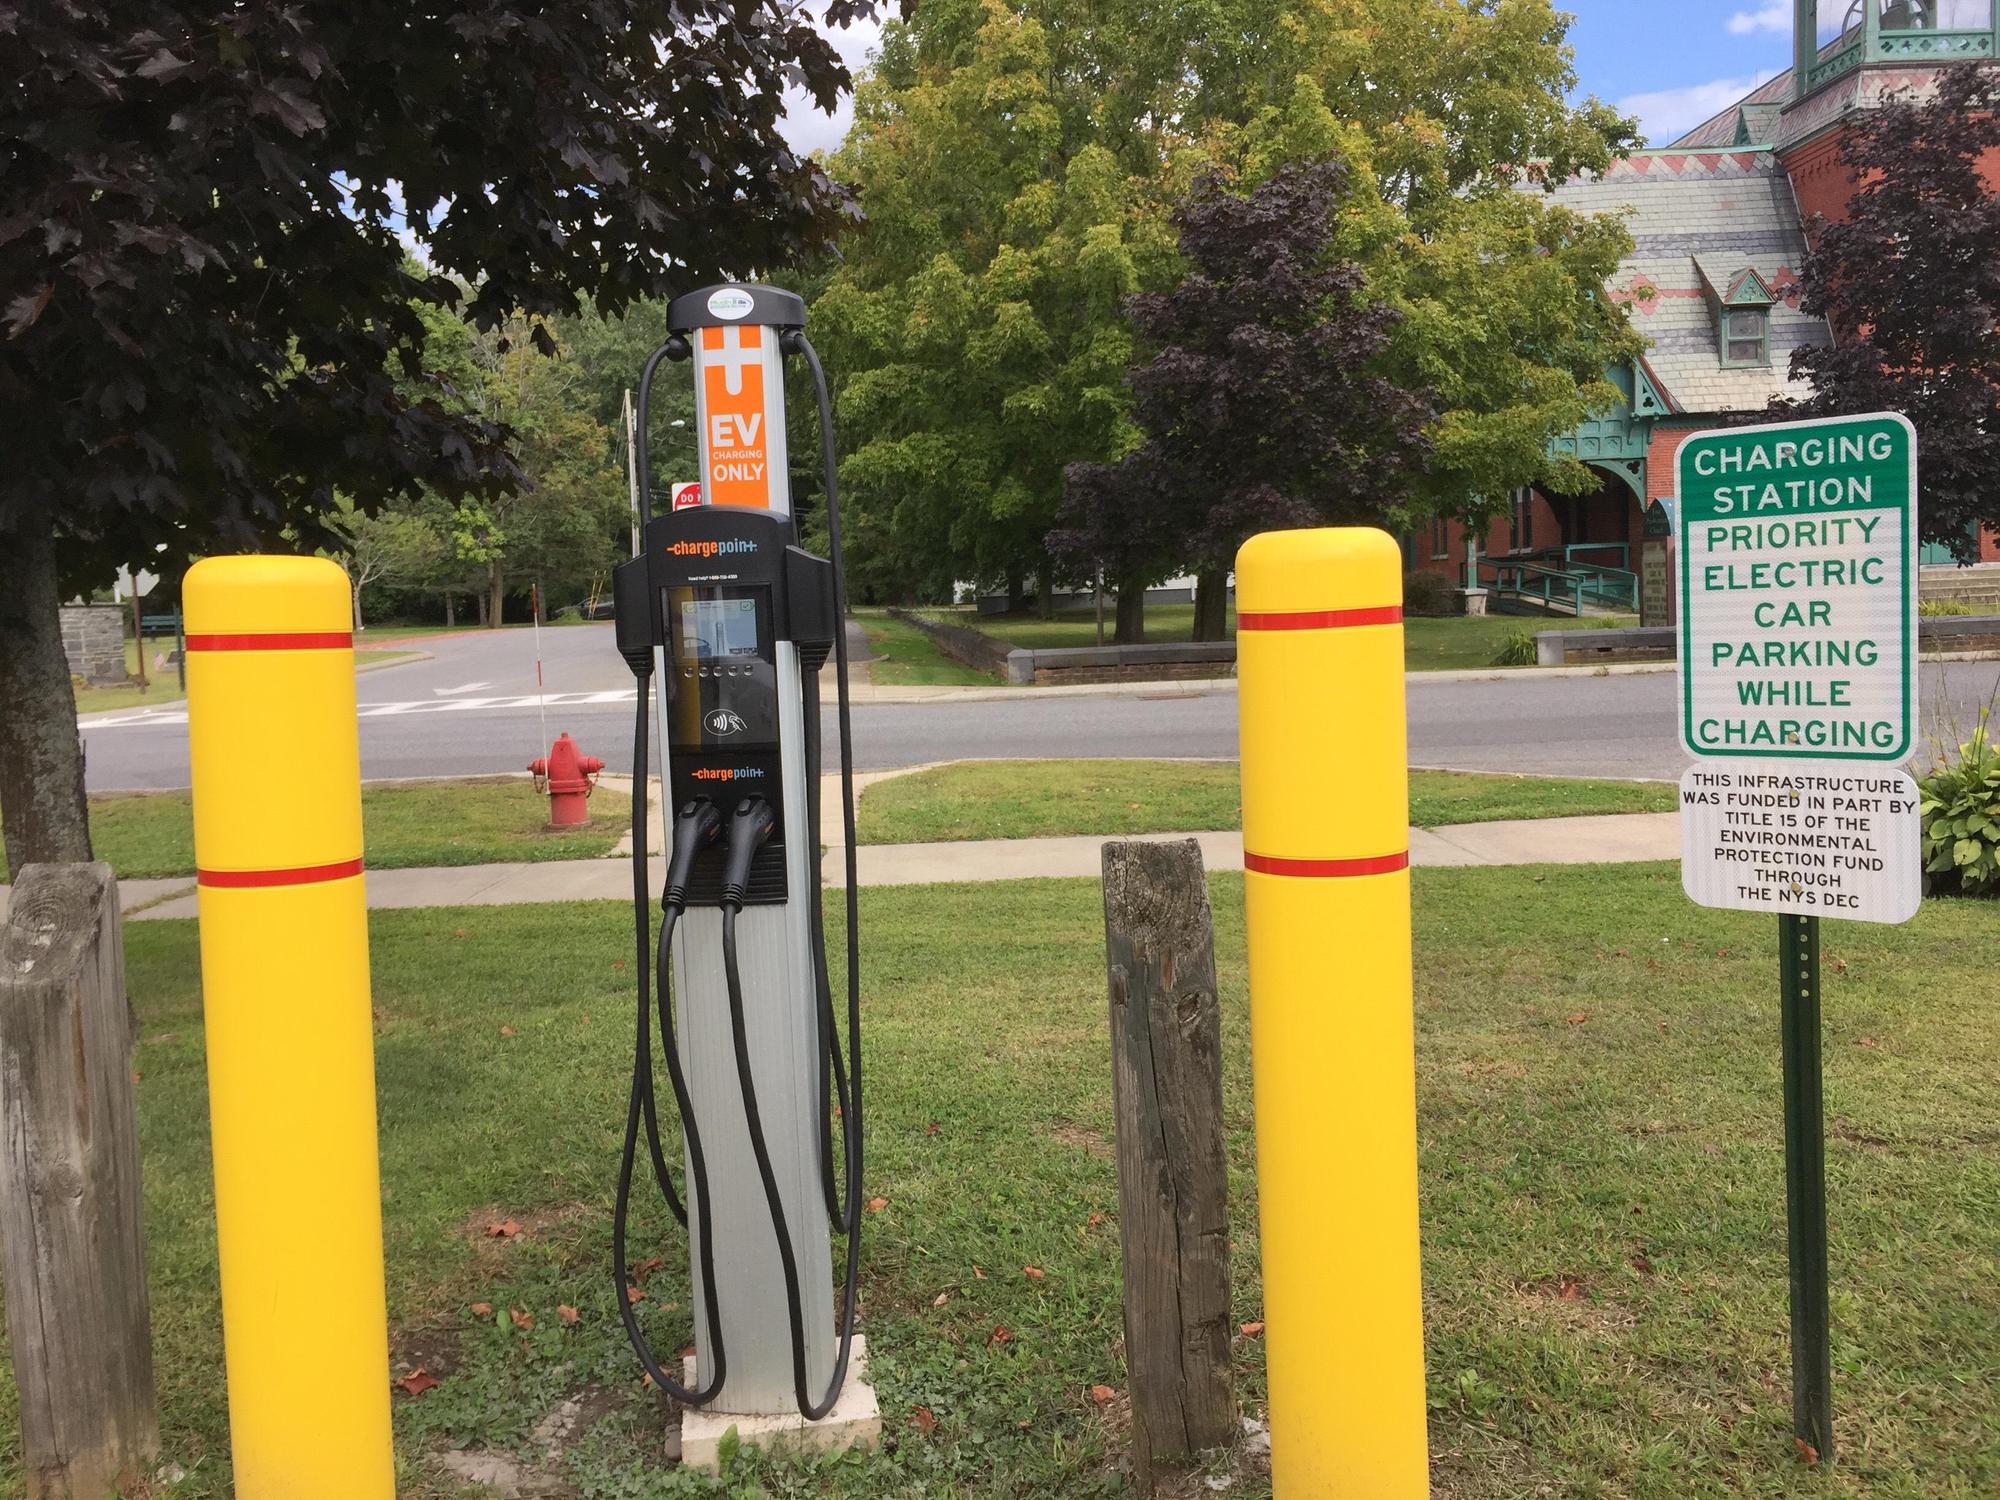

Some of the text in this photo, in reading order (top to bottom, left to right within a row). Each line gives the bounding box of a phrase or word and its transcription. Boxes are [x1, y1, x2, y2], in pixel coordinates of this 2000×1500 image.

[711, 413, 762, 448] EV
[712, 450, 763, 461] CHARGING
[1695, 432, 1893, 476] CHARGING
[713, 463, 765, 482] ONLY
[681, 493, 694, 503] DO
[1713, 475, 1872, 514] STATION
[1707, 516, 1881, 552] PRIORITY
[1704, 557, 1884, 591] ELECTRIC
[1754, 600, 1831, 628] CAR
[1712, 640, 1878, 668] PARKING
[1737, 681, 1851, 706] WHILE
[1700, 719, 1894, 748] CHARGING
[1692, 773, 1904, 794] THIS INFRASTRUCTURE
[1683, 792, 1916, 814] WAS FUNDED IN PART BY
[1725, 811, 1871, 832] TITLE 15 OF THE
[1720, 830, 1877, 852] ENVIRONMENTAL
[1714, 848, 1884, 872] PROTECTION FUND
[1754, 869, 1841, 888] THROUGH
[1737, 886, 1860, 909] THE NYS DEC
